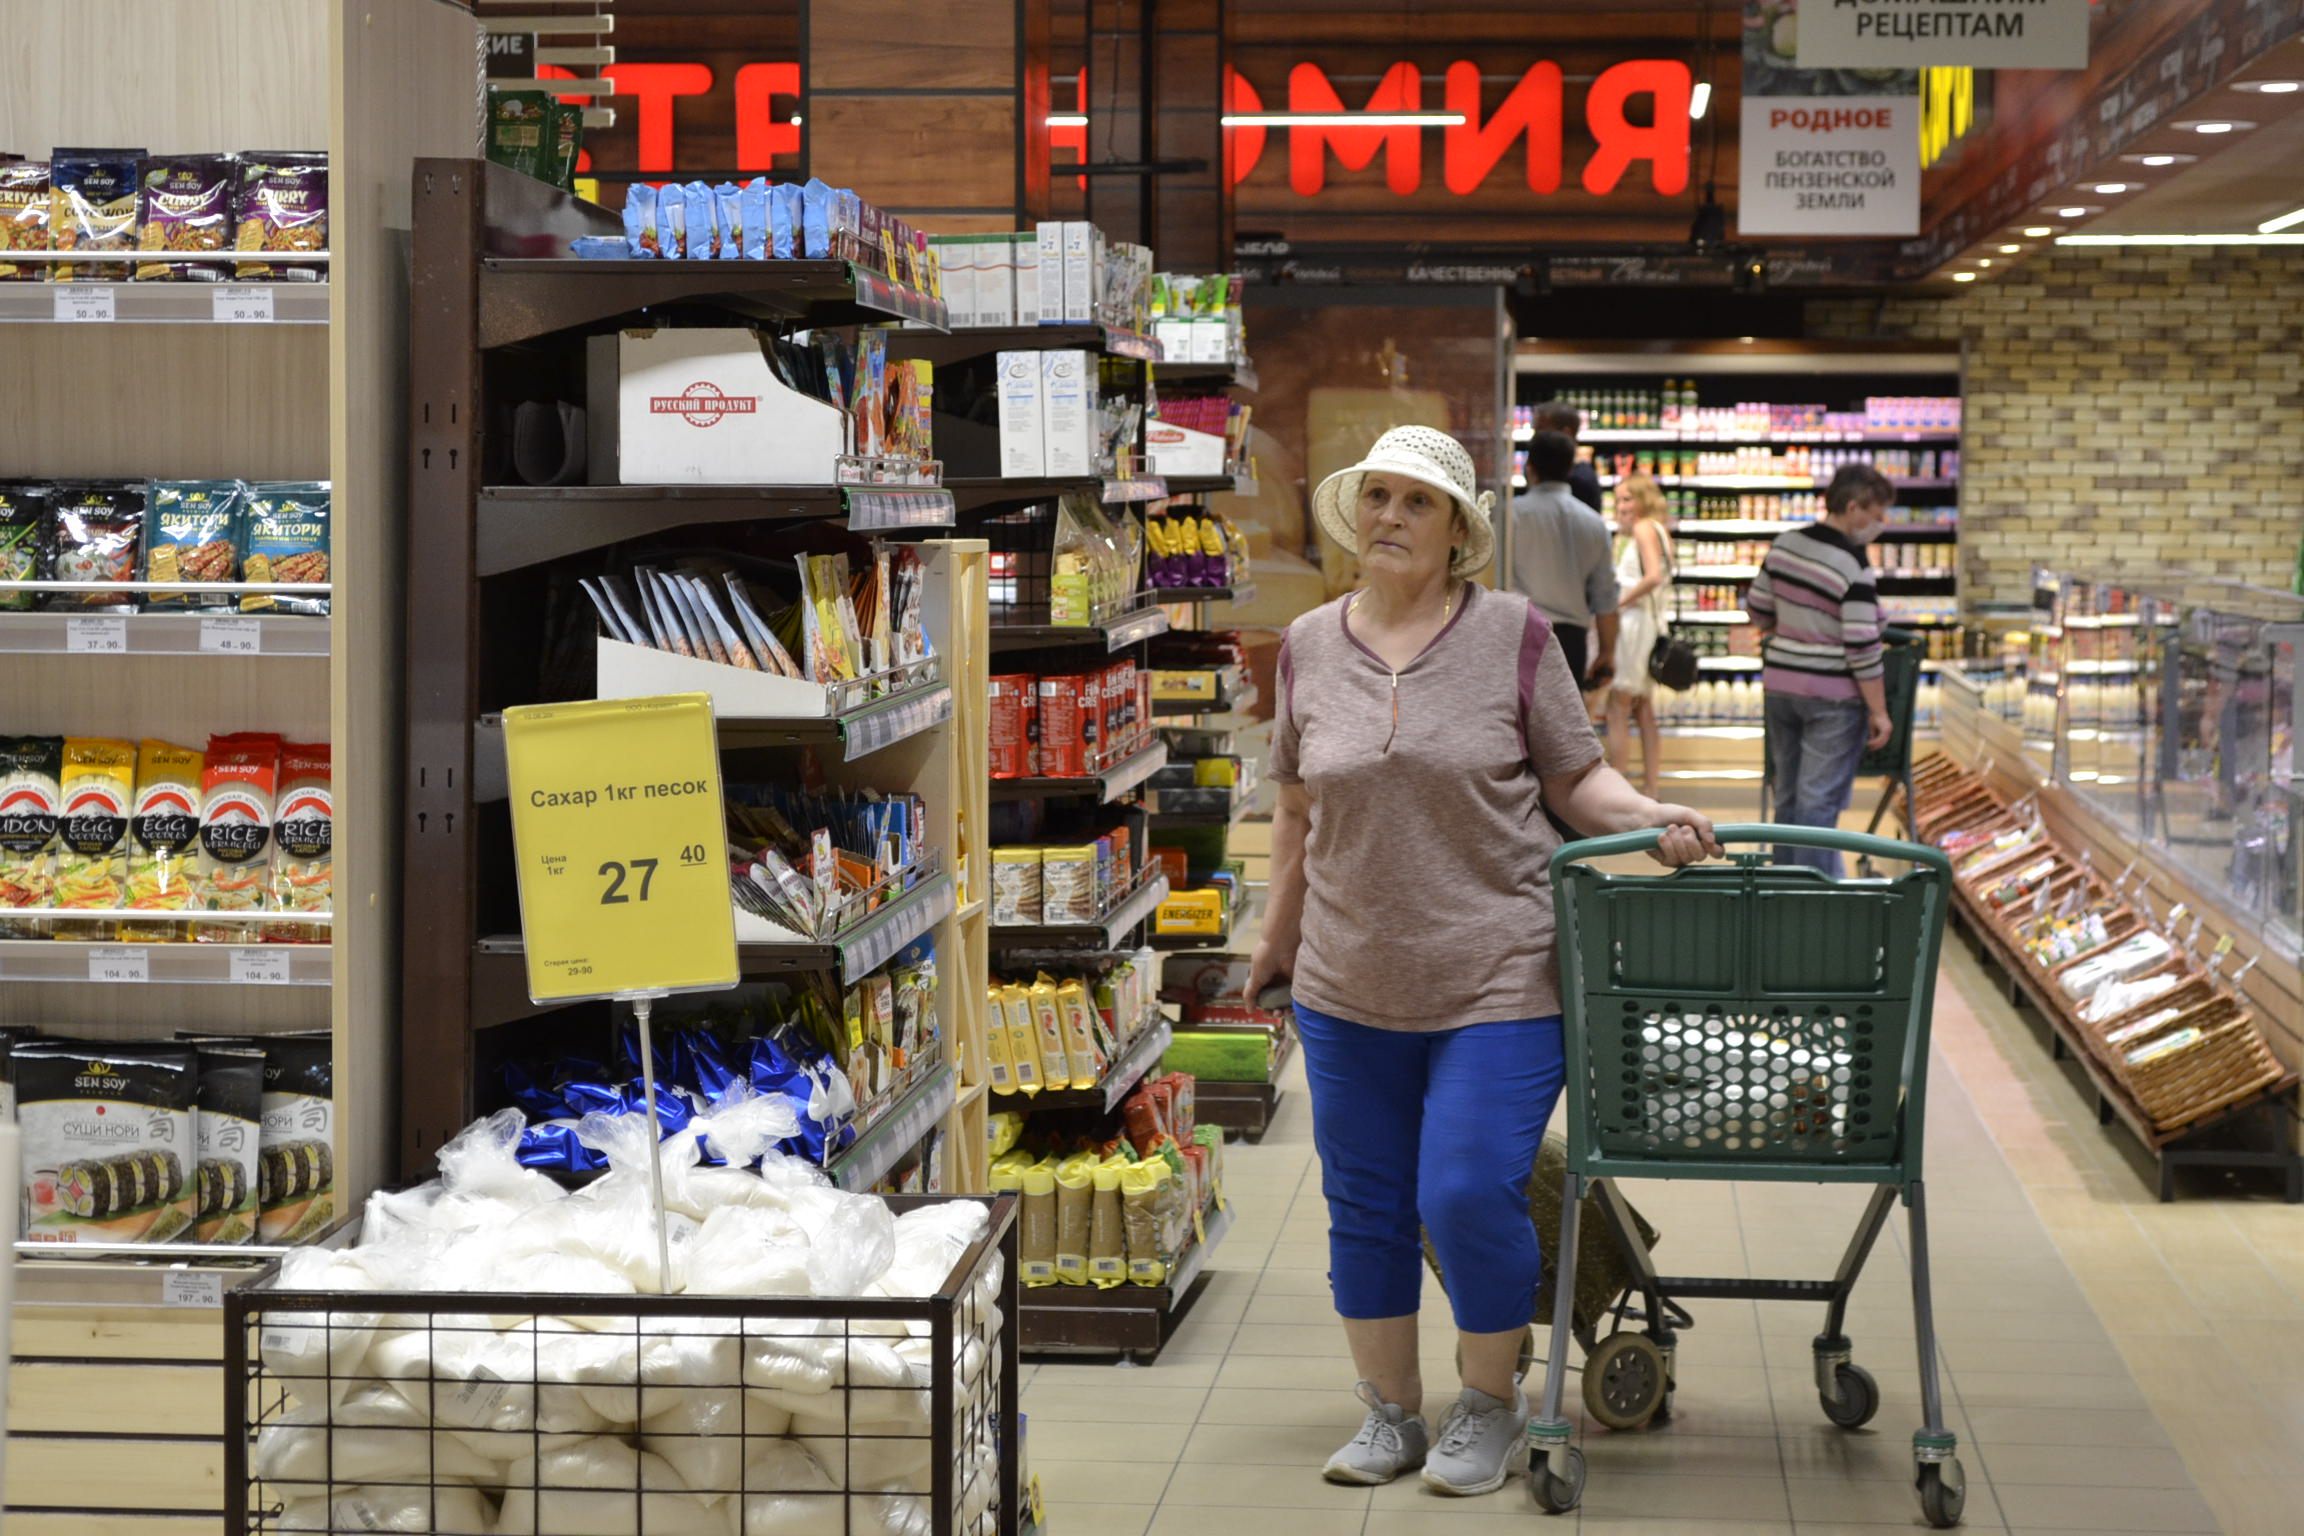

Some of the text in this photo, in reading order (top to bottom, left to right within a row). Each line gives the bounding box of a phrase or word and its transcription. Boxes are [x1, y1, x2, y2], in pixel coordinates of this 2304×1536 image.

[1857, 12, 2024, 40] РЕЦЕПТАМ
[1770, 108, 1891, 131] РОДНОЕ
[1775, 150, 1885, 168] БОГАТСТВО
[84, 178, 116, 187] SEN SOY
[268, 176, 302, 185] SEN SOY
[1766, 169, 1895, 188] ПЕНЗЕНСКОЙ
[186, 182, 202, 190] SOY
[158, 194, 211, 206] CURRY
[257, 190, 309, 205] CURRY
[1795, 193, 1865, 209] ЗЕМЛИ
[76, 310, 107, 318] 50 90
[234, 310, 265, 319] 50 90
[653, 399, 752, 413] РУССКИЙ ПРОДУКТ
[72, 506, 114, 517] SEN SOY
[180, 502, 212, 510] SEN SOY
[160, 512, 230, 526] ЯКИТОРИ
[272, 512, 304, 521] SEN SOY
[253, 523, 323, 537] ЯКИТОРИ
[87, 640, 118, 649] 37 90
[240, 641, 251, 649] 90
[28, 754, 47, 763] SOY
[98, 757, 117, 765] SOY
[172, 757, 192, 765] SOY
[218, 765, 259, 774] SEN SOY
[530, 779, 707, 808] Сахар 1кг песок
[69, 818, 112, 833] EGG
[143, 817, 186, 832] EGG
[284, 823, 331, 837] RICE
[210, 827, 257, 841] RICE
[205, 840, 261, 849] VERMICELLI
[279, 837, 331, 845] VERMICELL
[680, 844, 706, 863] 40
[541, 854, 567, 865] Цена
[547, 866, 565, 876] 1кг
[598, 858, 658, 905] 27
[1162, 908, 1214, 920] ENERGIZER
[544, 959, 569, 967] Старая
[104, 970, 140, 978] 104 90
[245, 972, 281, 980] 104 90
[567, 966, 593, 976] 29-90
[74, 1076, 126, 1091] SEN SOY
[62, 1122, 140, 1137] СУШИ НОРИ
[178, 1294, 213, 1304] 197 90
